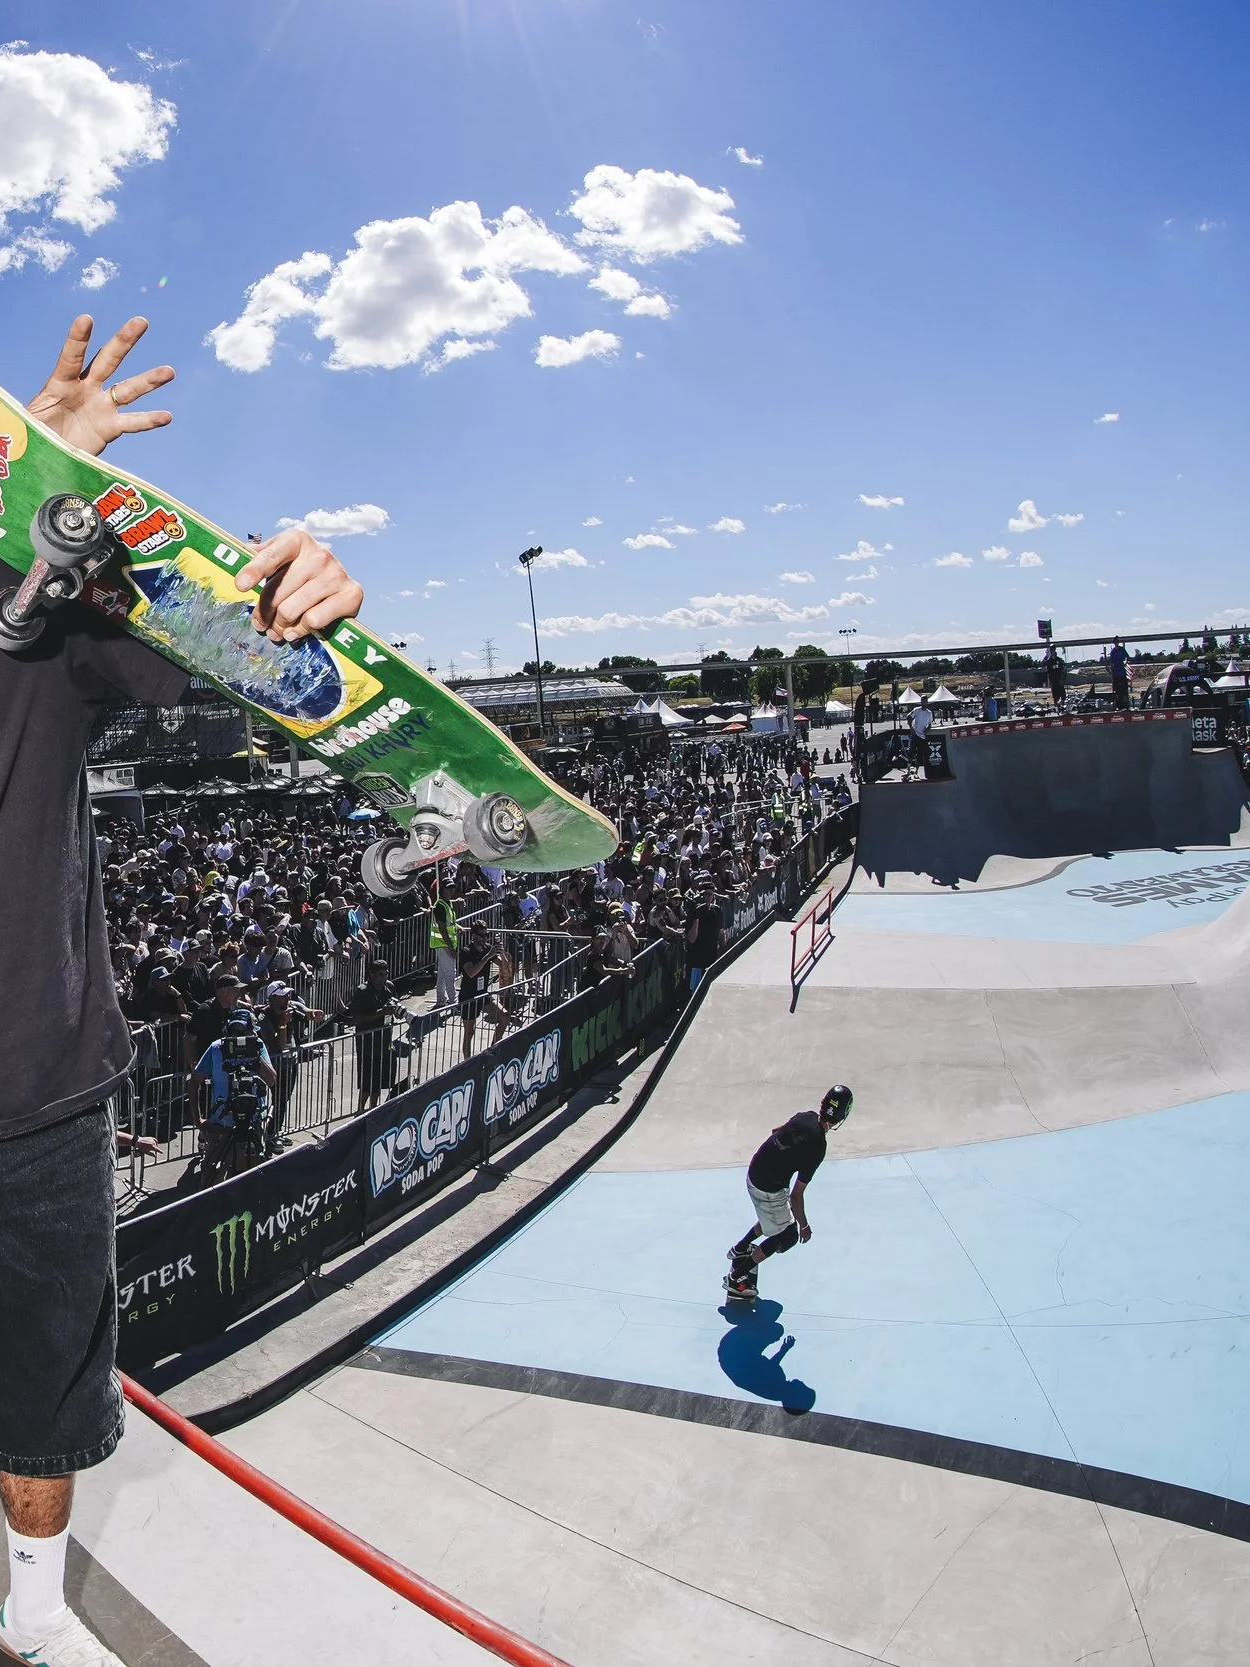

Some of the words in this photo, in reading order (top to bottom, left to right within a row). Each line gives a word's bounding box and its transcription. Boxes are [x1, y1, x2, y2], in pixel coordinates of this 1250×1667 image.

[120, 508, 177, 548] BRAWL
[140, 529, 170, 553] STARS
[308, 697, 411, 757] birdhouse
[1092, 868, 1250, 908] AMES
[571, 998, 622, 1072] KICK
[521, 1033, 559, 1091] CAP!
[421, 1083, 473, 1154] CAP!
[509, 1104, 528, 1126] SODA
[527, 1094, 538, 1112] POP
[401, 1167, 425, 1195] SODA
[427, 1153, 444, 1176] POP
[255, 1169, 358, 1243] MONSTER
[273, 1203, 343, 1252] ENERGY
[118, 1254, 196, 1310] STER
